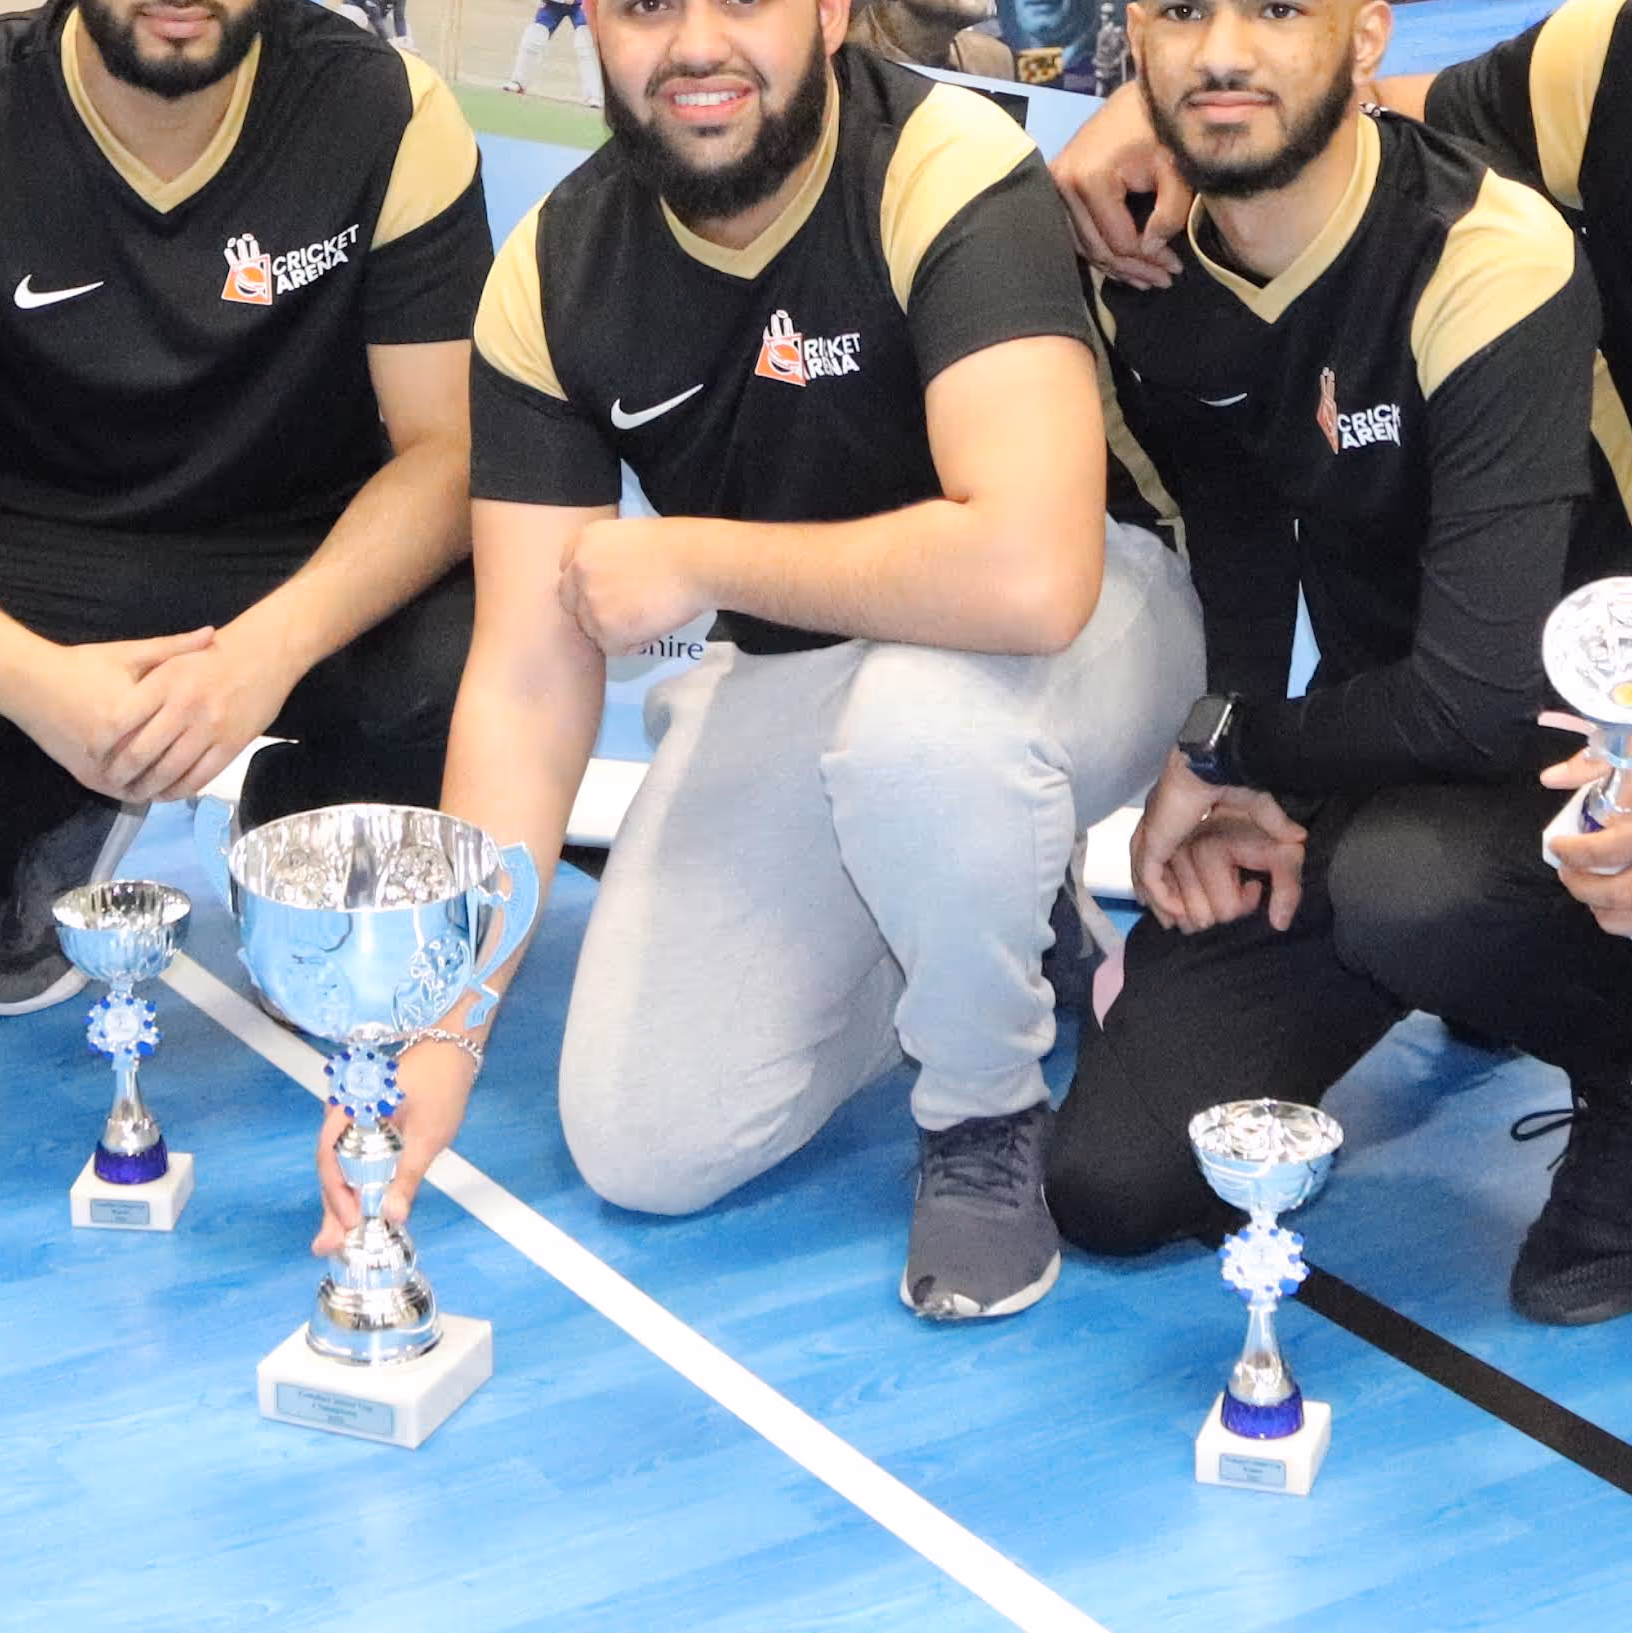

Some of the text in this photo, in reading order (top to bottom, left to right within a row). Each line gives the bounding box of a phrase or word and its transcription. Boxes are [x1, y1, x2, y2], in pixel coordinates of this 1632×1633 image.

[272, 224, 360, 276] CRICKET
[276, 249, 350, 295] ARENA
[1337, 403, 1402, 433] CRICK
[1342, 422, 1401, 449] AREN
